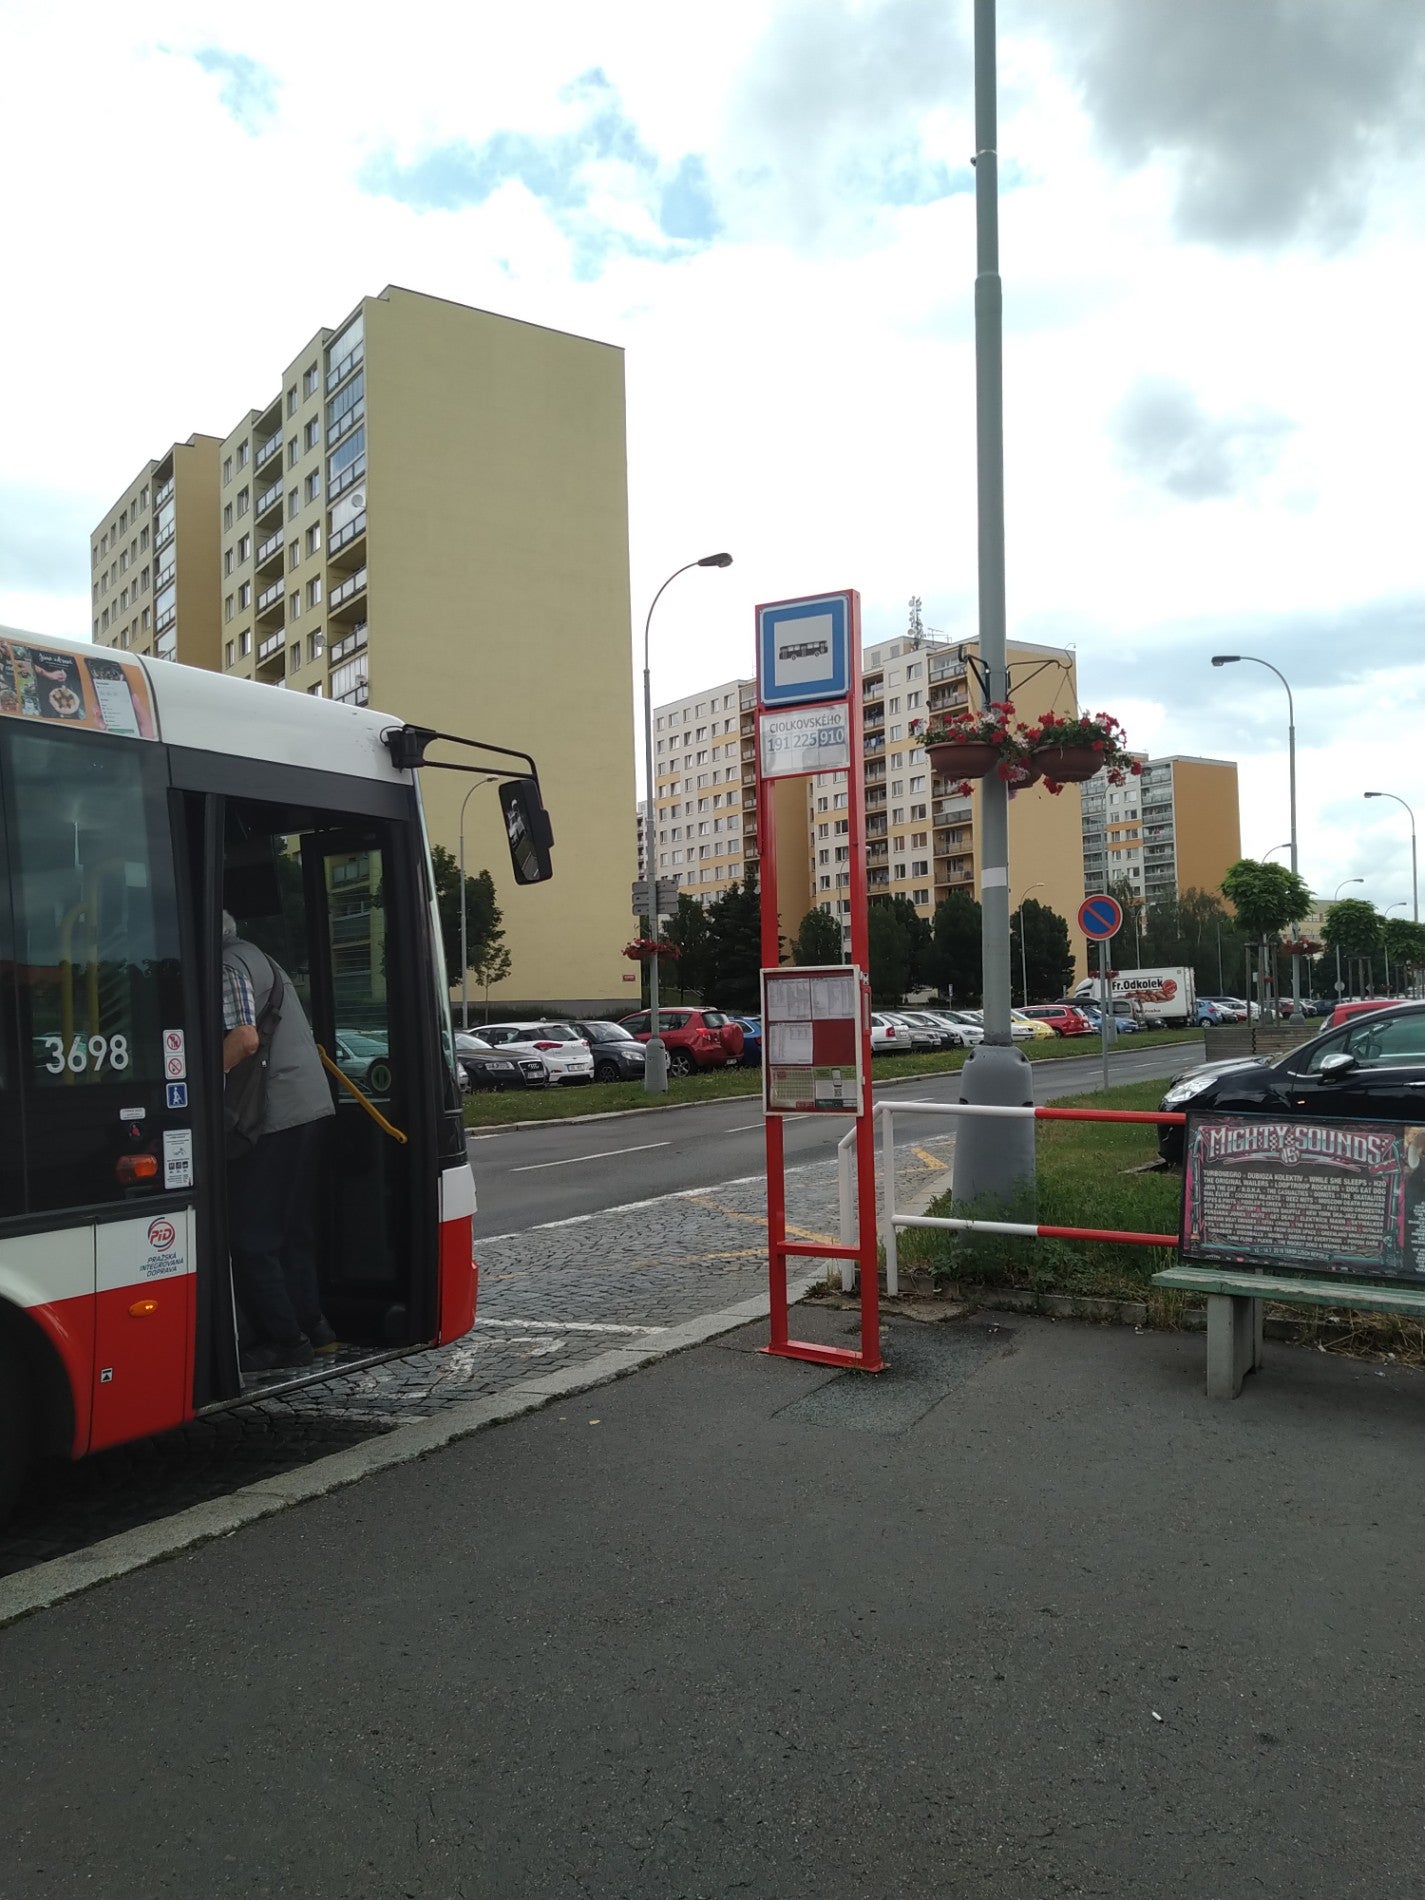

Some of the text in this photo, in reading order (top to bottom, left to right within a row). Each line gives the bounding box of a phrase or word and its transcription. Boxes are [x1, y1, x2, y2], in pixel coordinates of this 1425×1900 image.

[769, 714, 842, 734] CIOLKOVSKÉHO
[768, 728, 844, 752] 191 225 910
[45, 1034, 129, 1074] 3698
[1210, 1126, 1382, 1164] MIGHTY SOUNDS
[1203, 1169, 1241, 1178] TURBONEGRO
[1330, 1177, 1342, 1185] SHE
[1344, 1178, 1367, 1186] SLEEPS
[1215, 1177, 1242, 1185] ORIGINAL
[1243, 1179, 1269, 1187] WAILERS
[1311, 1184, 1340, 1192] ROCKERS
